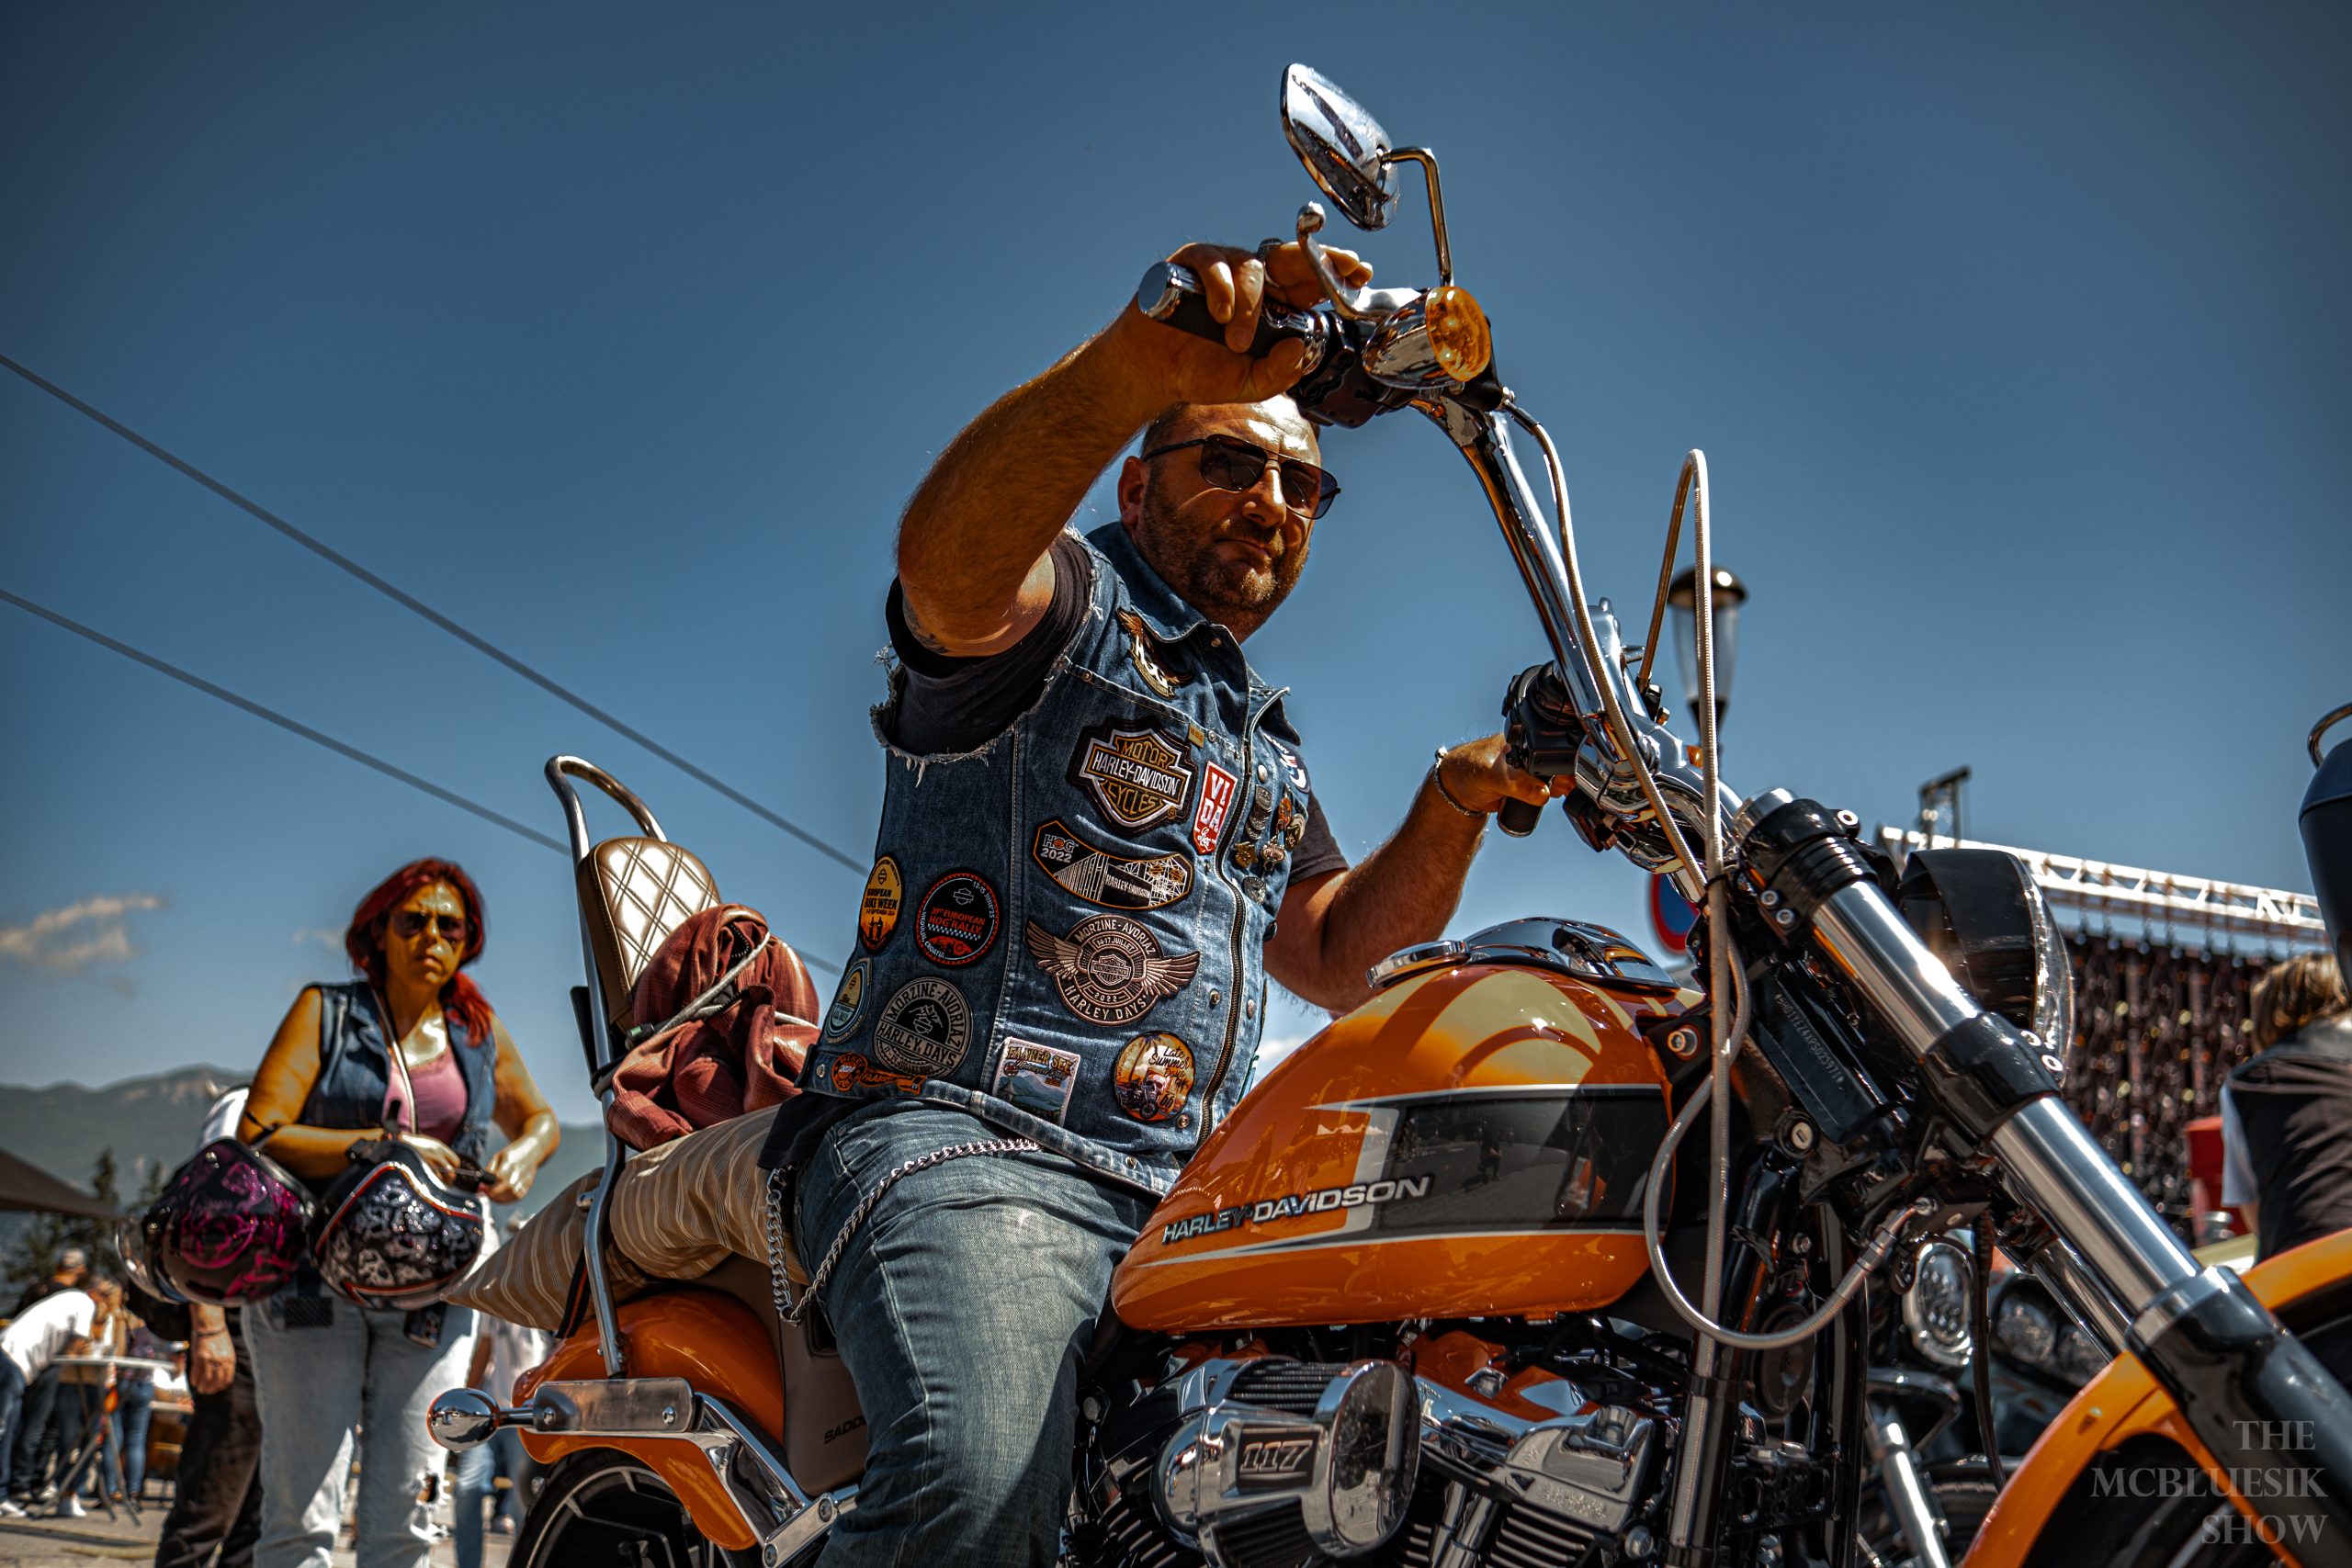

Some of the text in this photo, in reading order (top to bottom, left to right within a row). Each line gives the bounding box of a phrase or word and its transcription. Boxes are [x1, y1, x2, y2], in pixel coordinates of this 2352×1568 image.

[1121, 741, 1168, 768] MOTOR
[1092, 750, 1181, 796] HARLEY-DAVIDSON
[1108, 782, 1158, 816] CYCLES
[1212, 773, 1231, 807] VI
[1200, 797, 1224, 833] DA
[1040, 848, 1073, 863] 2022
[877, 899, 898, 910] WEEK
[944, 909, 986, 925] EUROPEAN
[951, 919, 982, 934] RALLY
[1065, 985, 1110, 1021] HARLEY
[1094, 992, 1118, 1002] 2022
[876, 1022, 922, 1051] HARLEY
[923, 1043, 956, 1067] DAYS
[1163, 1045, 1185, 1059] Late
[1051, 1055, 1073, 1074] SEE
[1148, 1053, 1191, 1071] Summer
[1159, 1093, 1175, 1109] 66
[1161, 1176, 1433, 1244] HARLEY-DAVIDSON
[1239, 1439, 1313, 1473] 117
